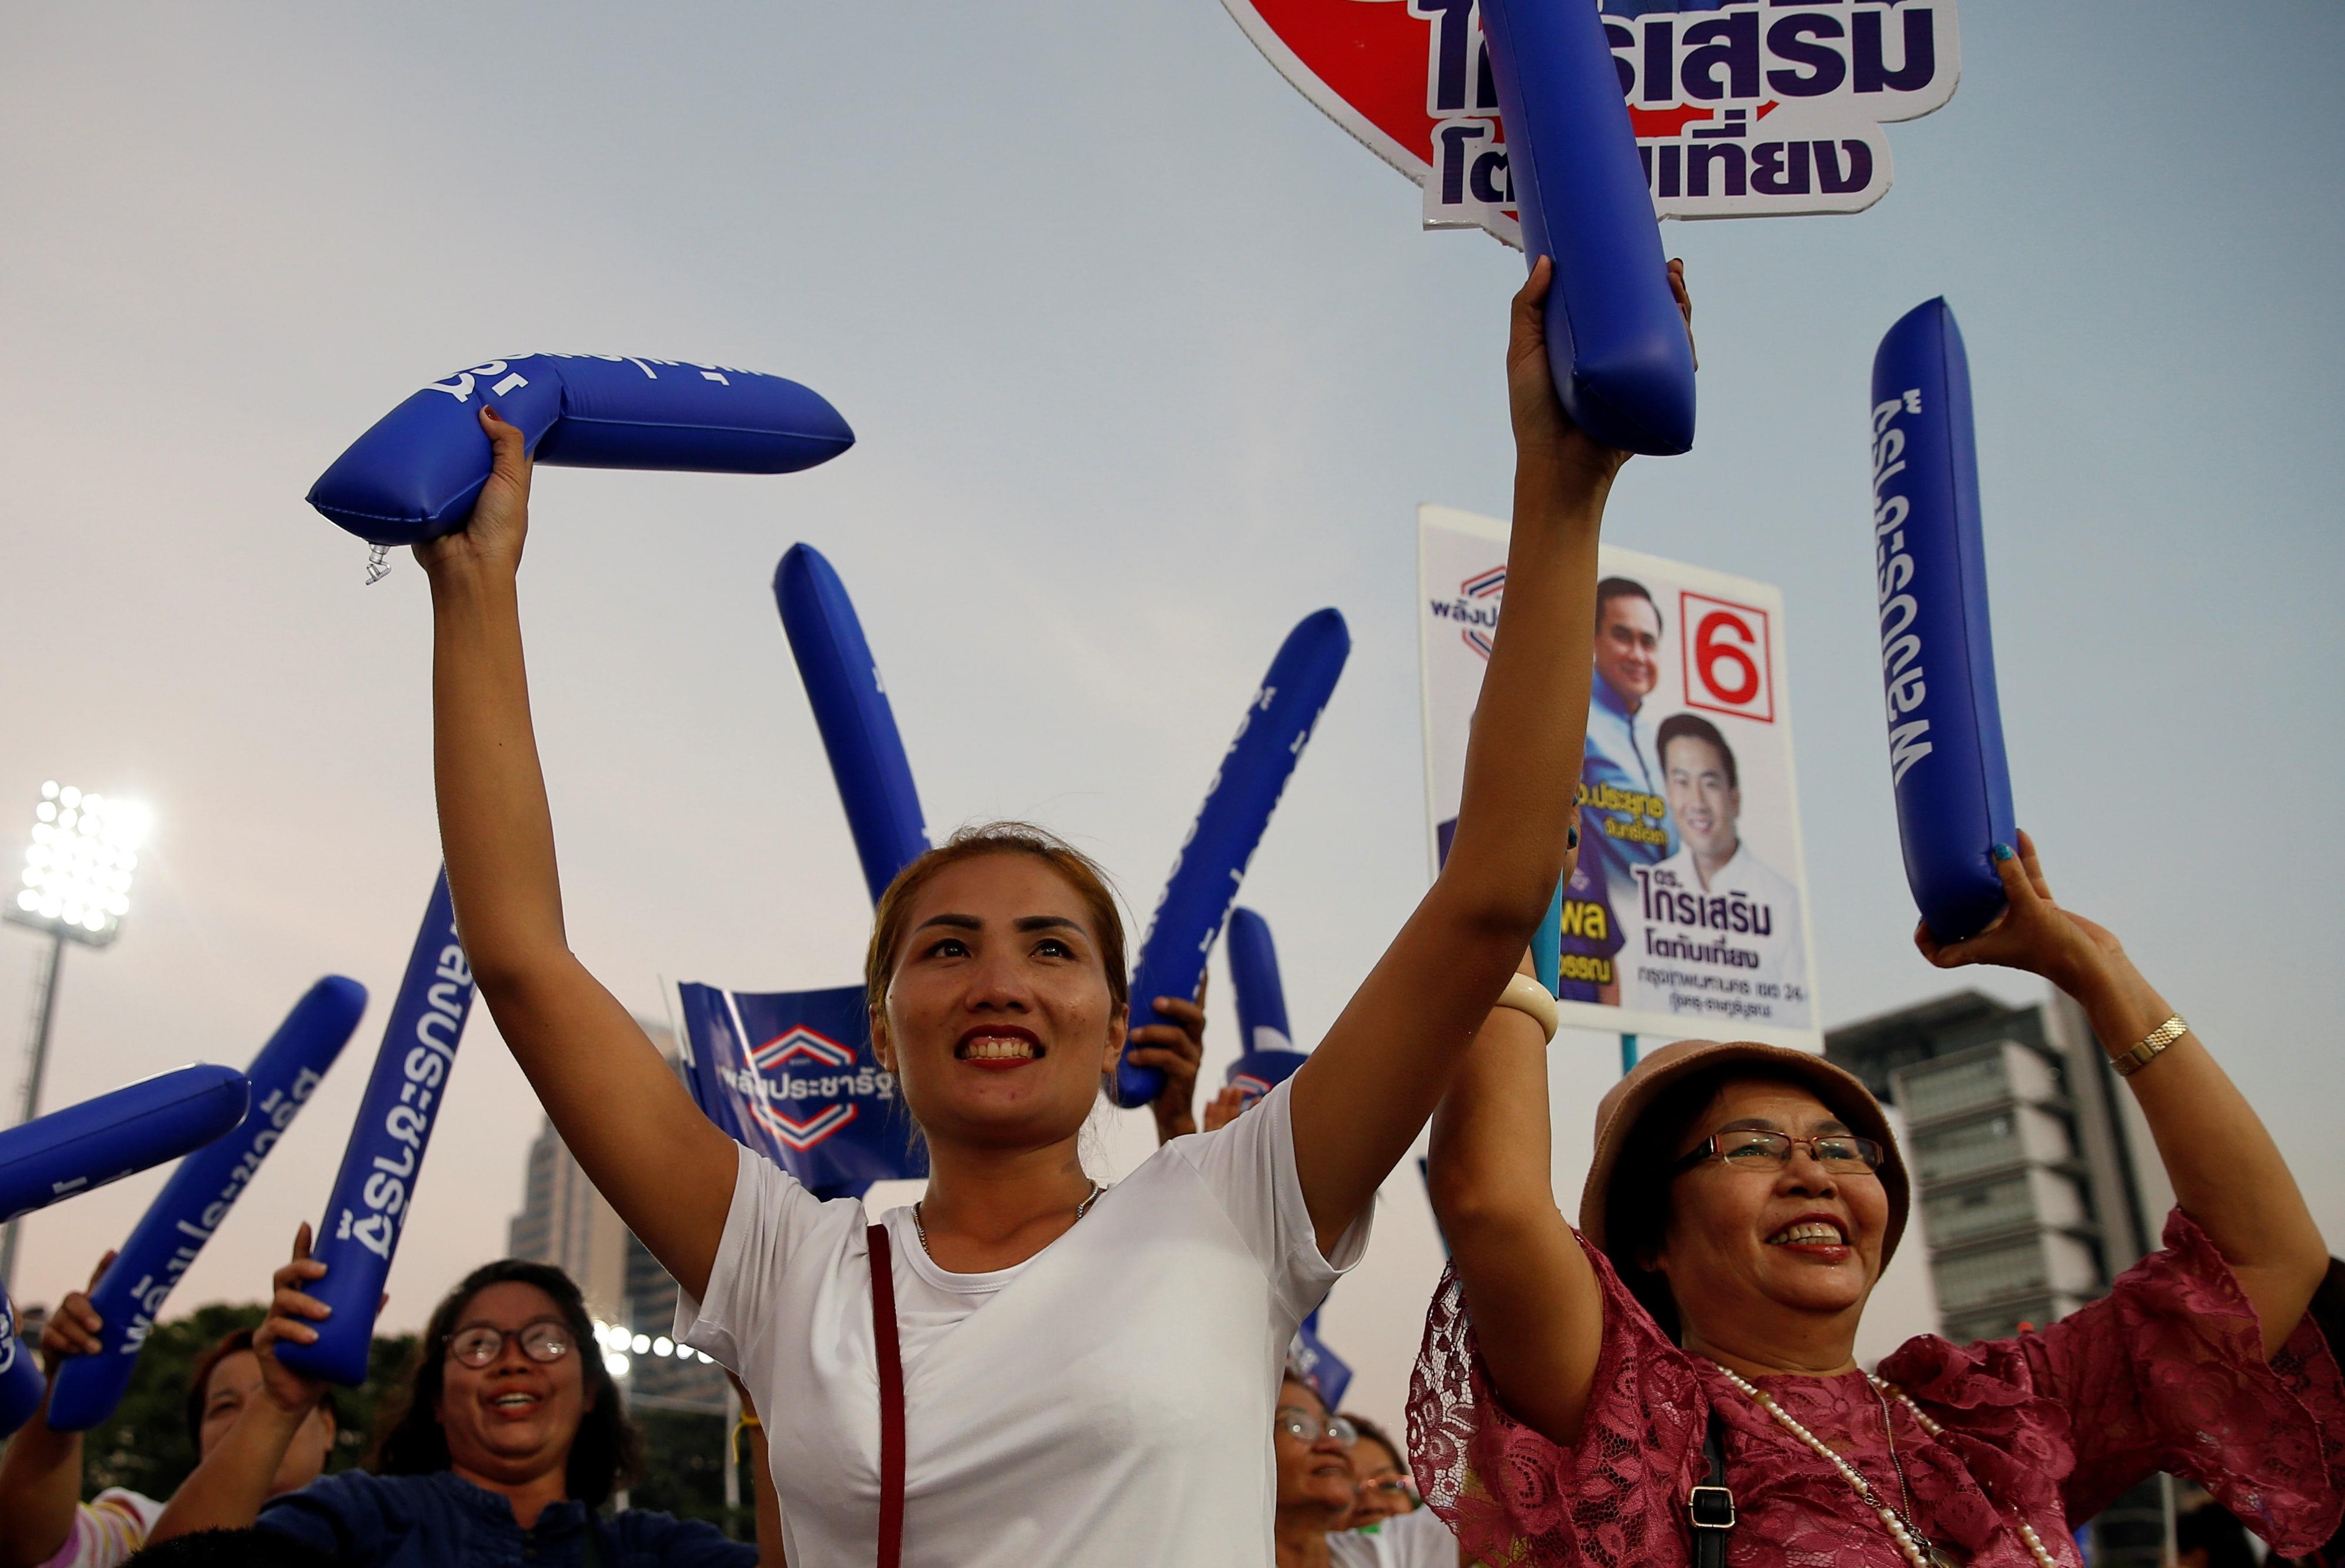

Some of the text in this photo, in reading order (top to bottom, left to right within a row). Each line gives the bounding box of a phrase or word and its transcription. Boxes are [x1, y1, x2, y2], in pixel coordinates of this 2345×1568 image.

[1696, 611, 1759, 705] 6
[1636, 870, 1770, 936] ไกรเสริม
